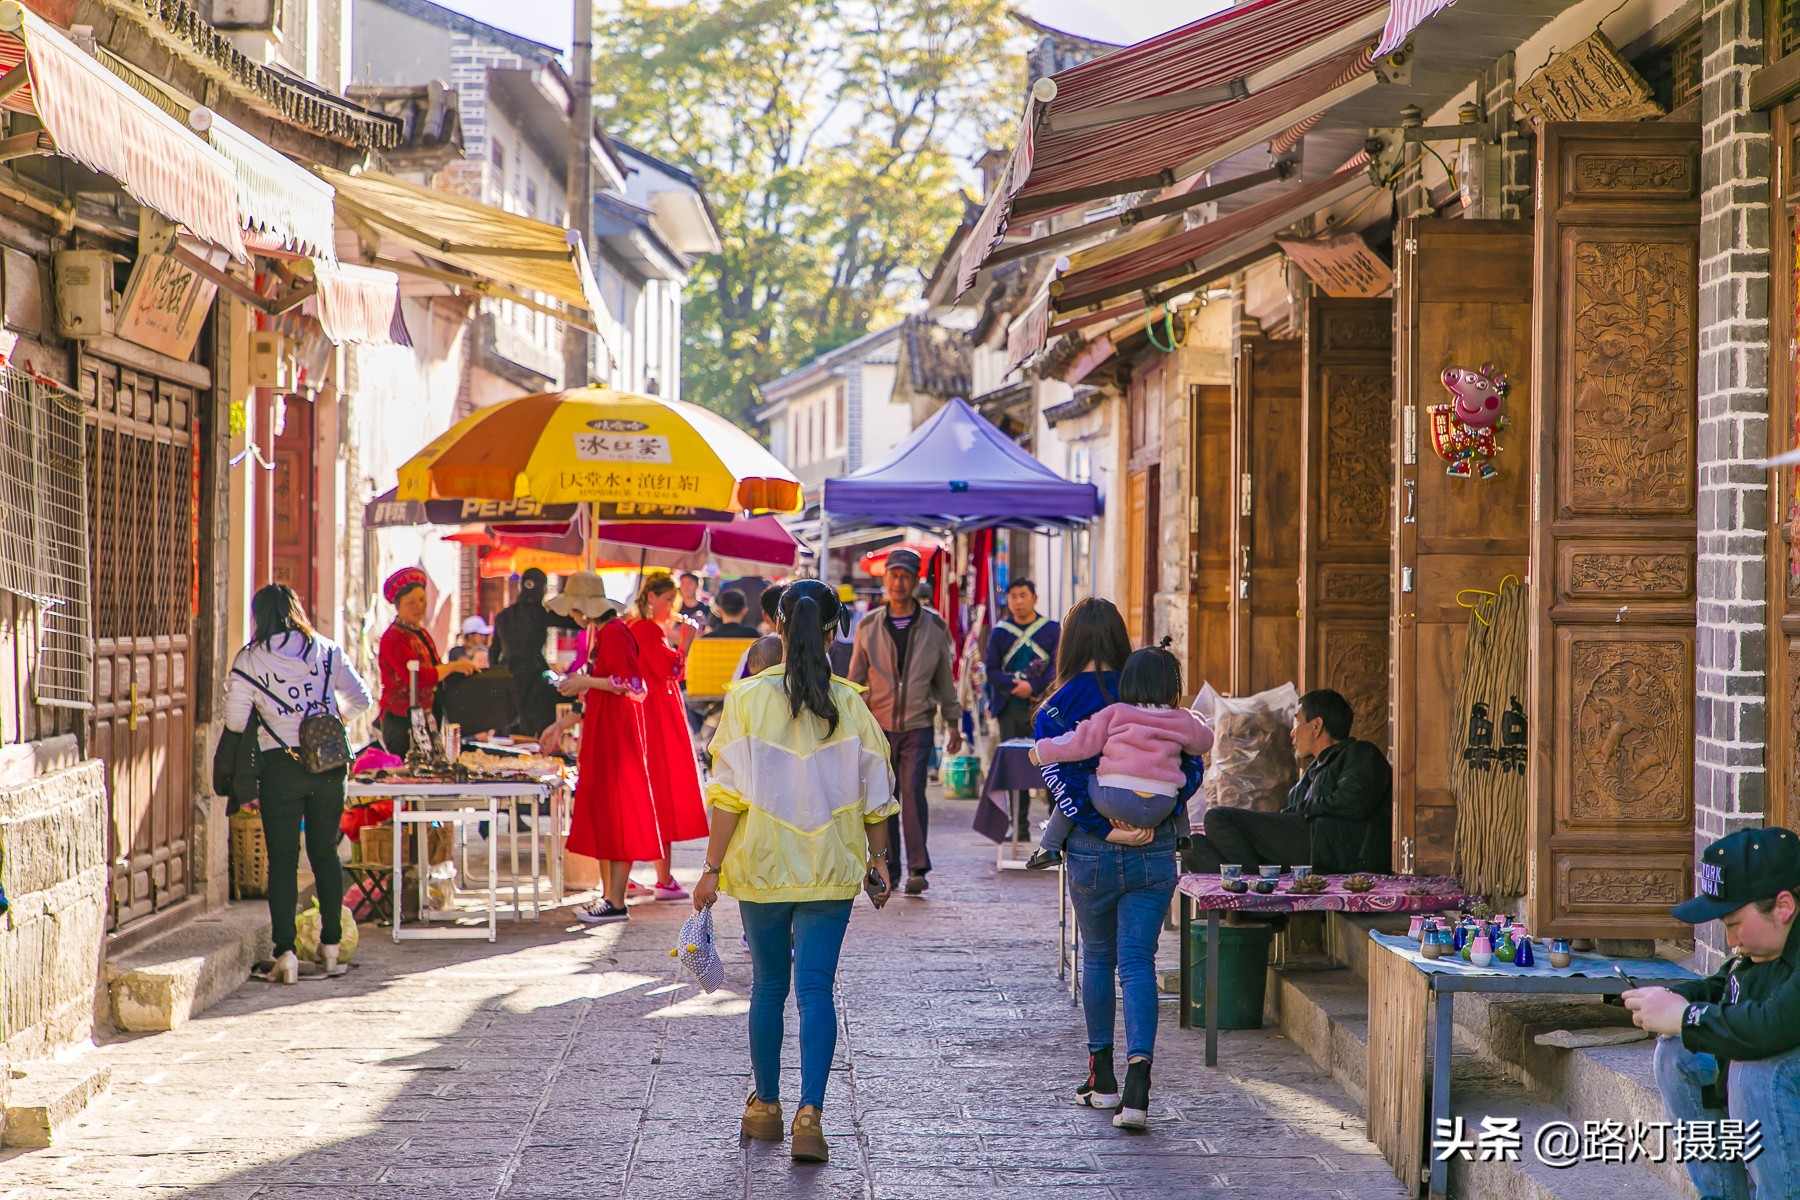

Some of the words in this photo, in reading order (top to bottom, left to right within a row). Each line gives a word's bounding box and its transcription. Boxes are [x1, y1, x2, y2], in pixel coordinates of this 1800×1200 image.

[580, 436, 662, 455] 冰红茶
[460, 496, 543, 519] PEPSI
[288, 682, 313, 699] OF
